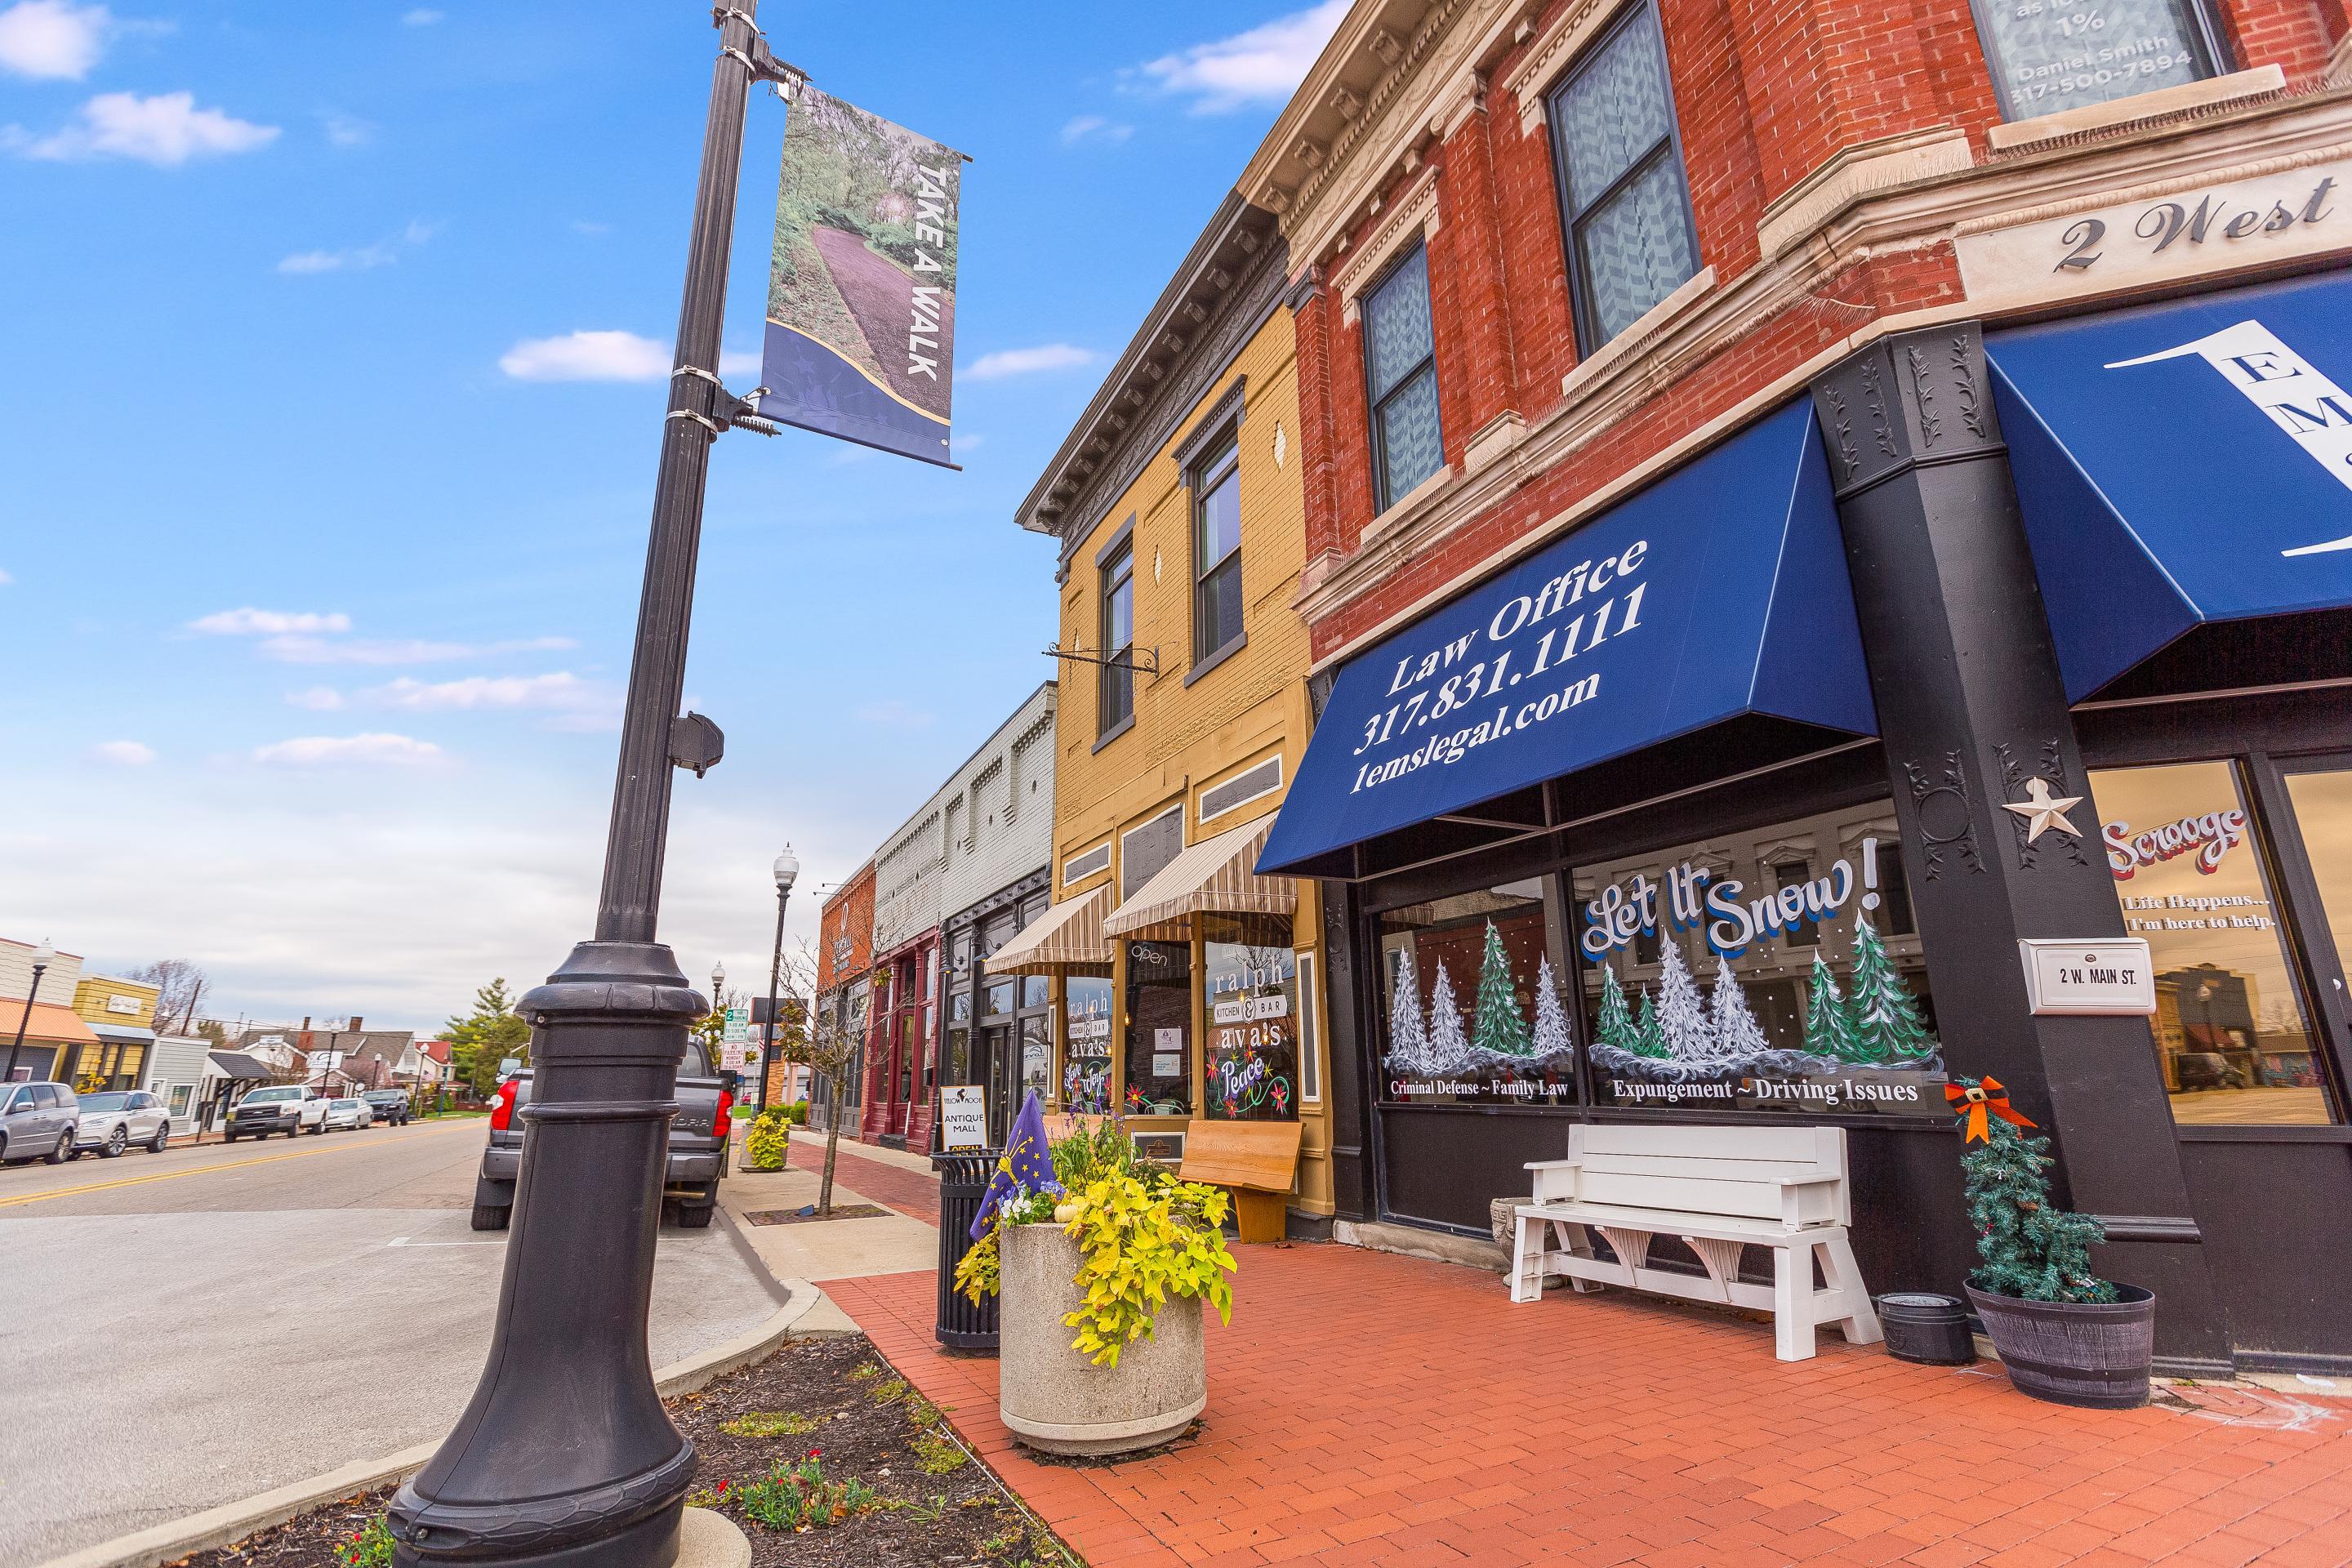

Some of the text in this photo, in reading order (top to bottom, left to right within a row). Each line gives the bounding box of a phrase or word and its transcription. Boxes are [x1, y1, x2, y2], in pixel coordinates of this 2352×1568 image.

[2056, 9, 2105, 38] 1%
[2018, 36, 2169, 82] Daniel Smith
[2011, 51, 2192, 104] 317-500-7894
[2052, 176, 2338, 274] 2 West
[907, 163, 947, 382] TAKE A WALK
[1385, 541, 1648, 697] Law Office
[1353, 582, 1647, 756] 317.831.1111
[1349, 673, 1601, 795] 1emslegal.com
[2101, 809, 2247, 879] Scrooge
[1581, 837, 1880, 958] Let It Snow!
[2125, 894, 2270, 911] Life Happens...
[2131, 915, 2276, 930] I'm here to help.
[1132, 946, 1167, 966] open
[1215, 956, 1284, 997] ralph
[2060, 969, 2136, 985] 2 W. MAIN ST.
[727, 1011, 733, 1020] 2
[1070, 990, 1107, 1020] ralph
[1216, 1000, 1281, 1018] KITCHEN & BAR
[1071, 1040, 1104, 1058] ava's
[1222, 1022, 1281, 1049] ava's
[1064, 1062, 1081, 1089] Love
[1221, 1058, 1264, 1098] Peace
[1390, 1080, 1435, 1095] Criminal
[1437, 1080, 1479, 1095] Defense
[1493, 1079, 1535, 1098] Family
[1538, 1079, 1568, 1095] Law
[1612, 1080, 1733, 1102] Expungement
[1754, 1079, 1840, 1105] Driving
[1842, 1079, 1919, 1102] Issues
[672, 1118, 710, 1127] DRA
[945, 1114, 984, 1123] ANTIQUE
